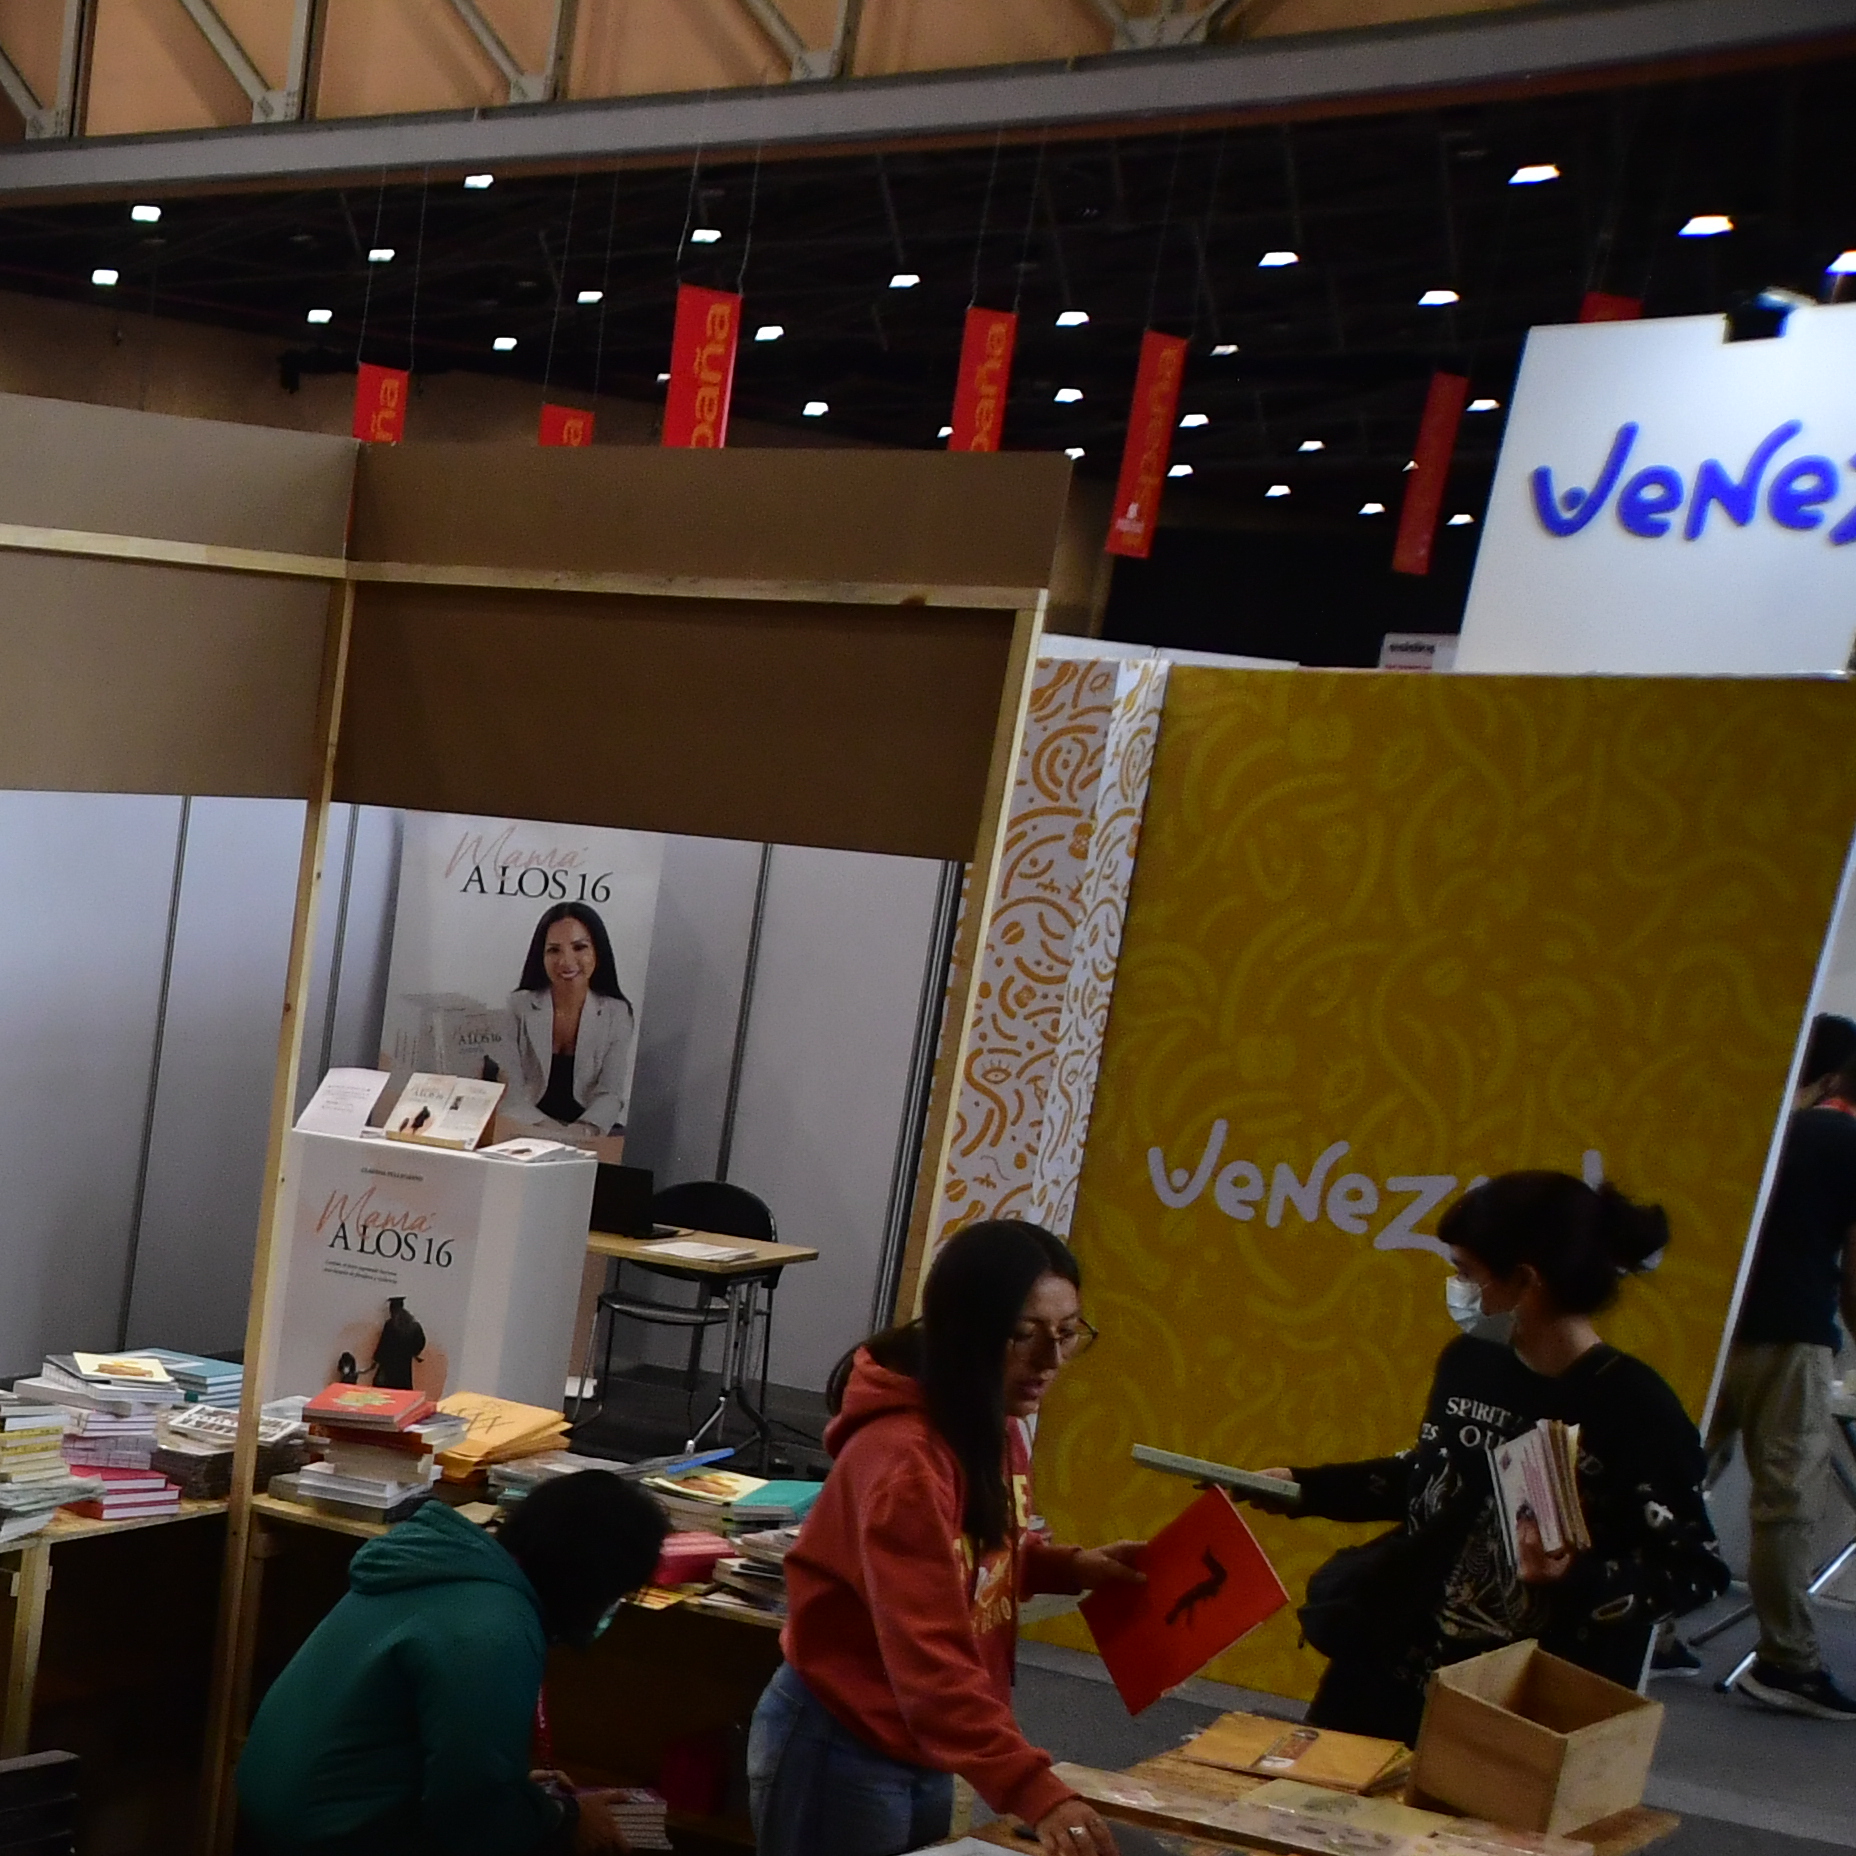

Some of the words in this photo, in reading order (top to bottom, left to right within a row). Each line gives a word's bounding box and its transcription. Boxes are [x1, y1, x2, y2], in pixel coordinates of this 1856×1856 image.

[460, 864, 488, 894] A
[496, 865, 567, 900] LOS
[575, 871, 613, 903] 16
[328, 1222, 352, 1252] A
[358, 1224, 419, 1263] LOS
[423, 1237, 456, 1268] 16
